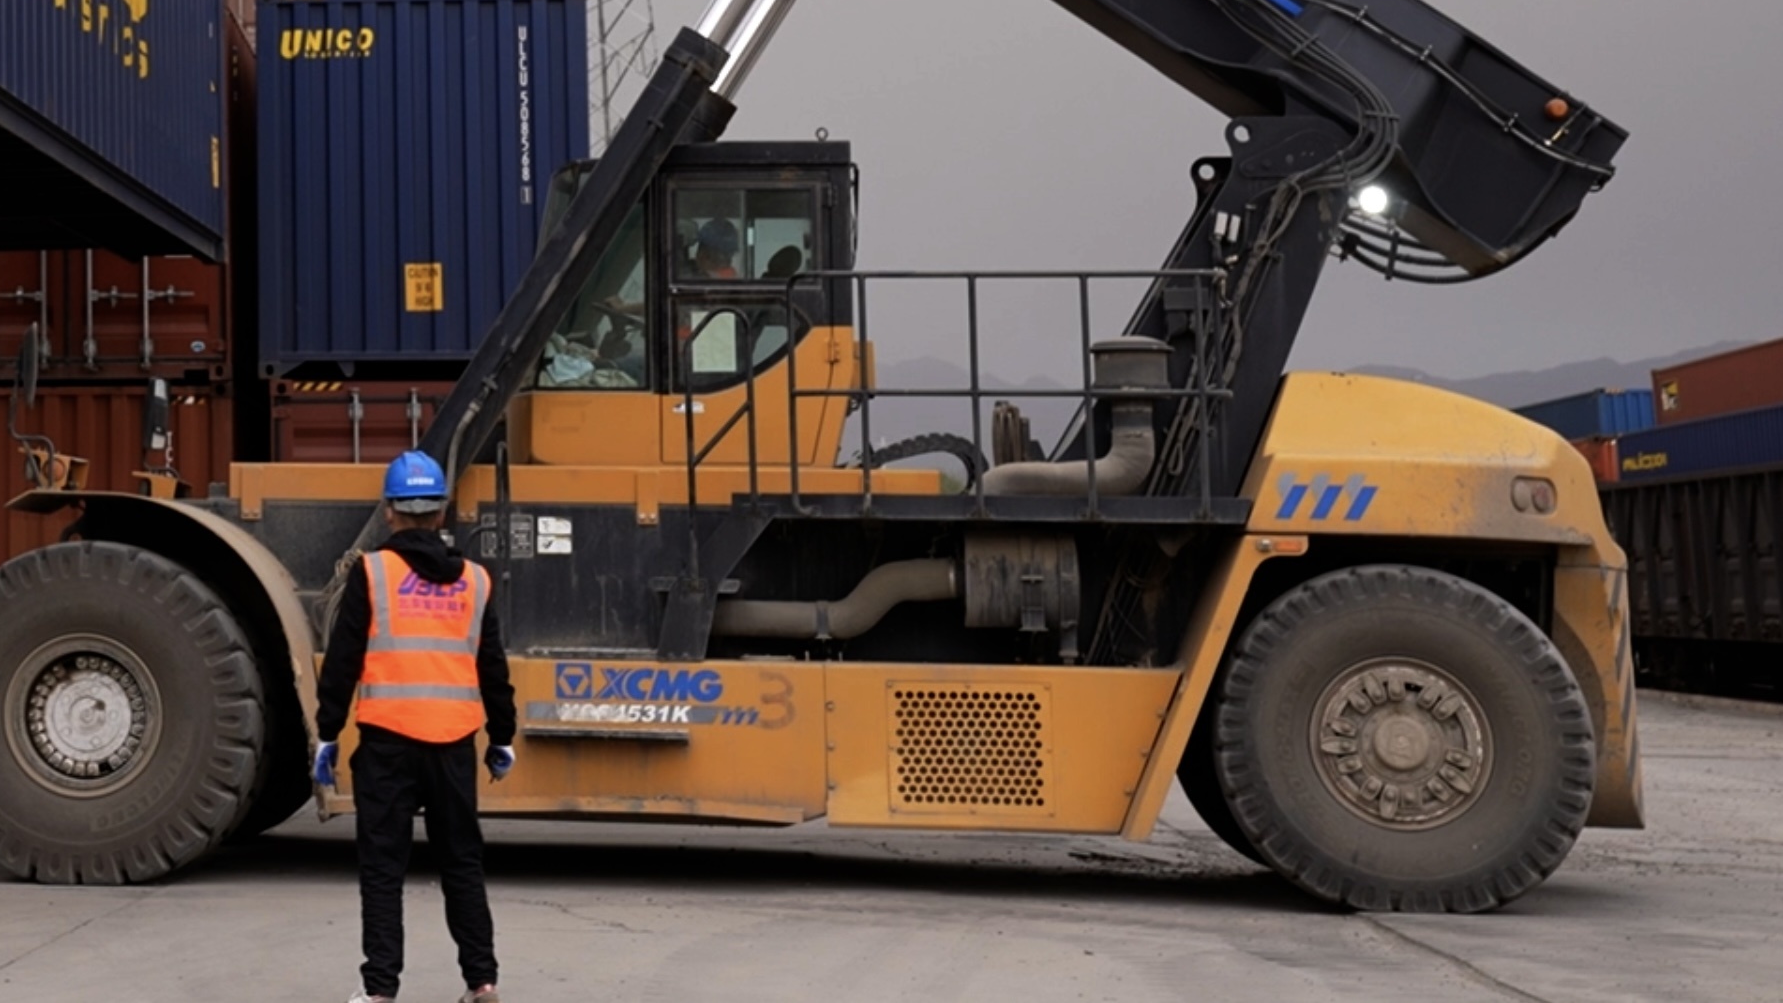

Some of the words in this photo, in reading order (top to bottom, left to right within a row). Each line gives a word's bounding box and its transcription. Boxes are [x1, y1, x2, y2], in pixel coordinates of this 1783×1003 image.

[281, 27, 374, 59] UNICO
[596, 668, 724, 702] XCMG
[557, 703, 692, 724] 4531K
